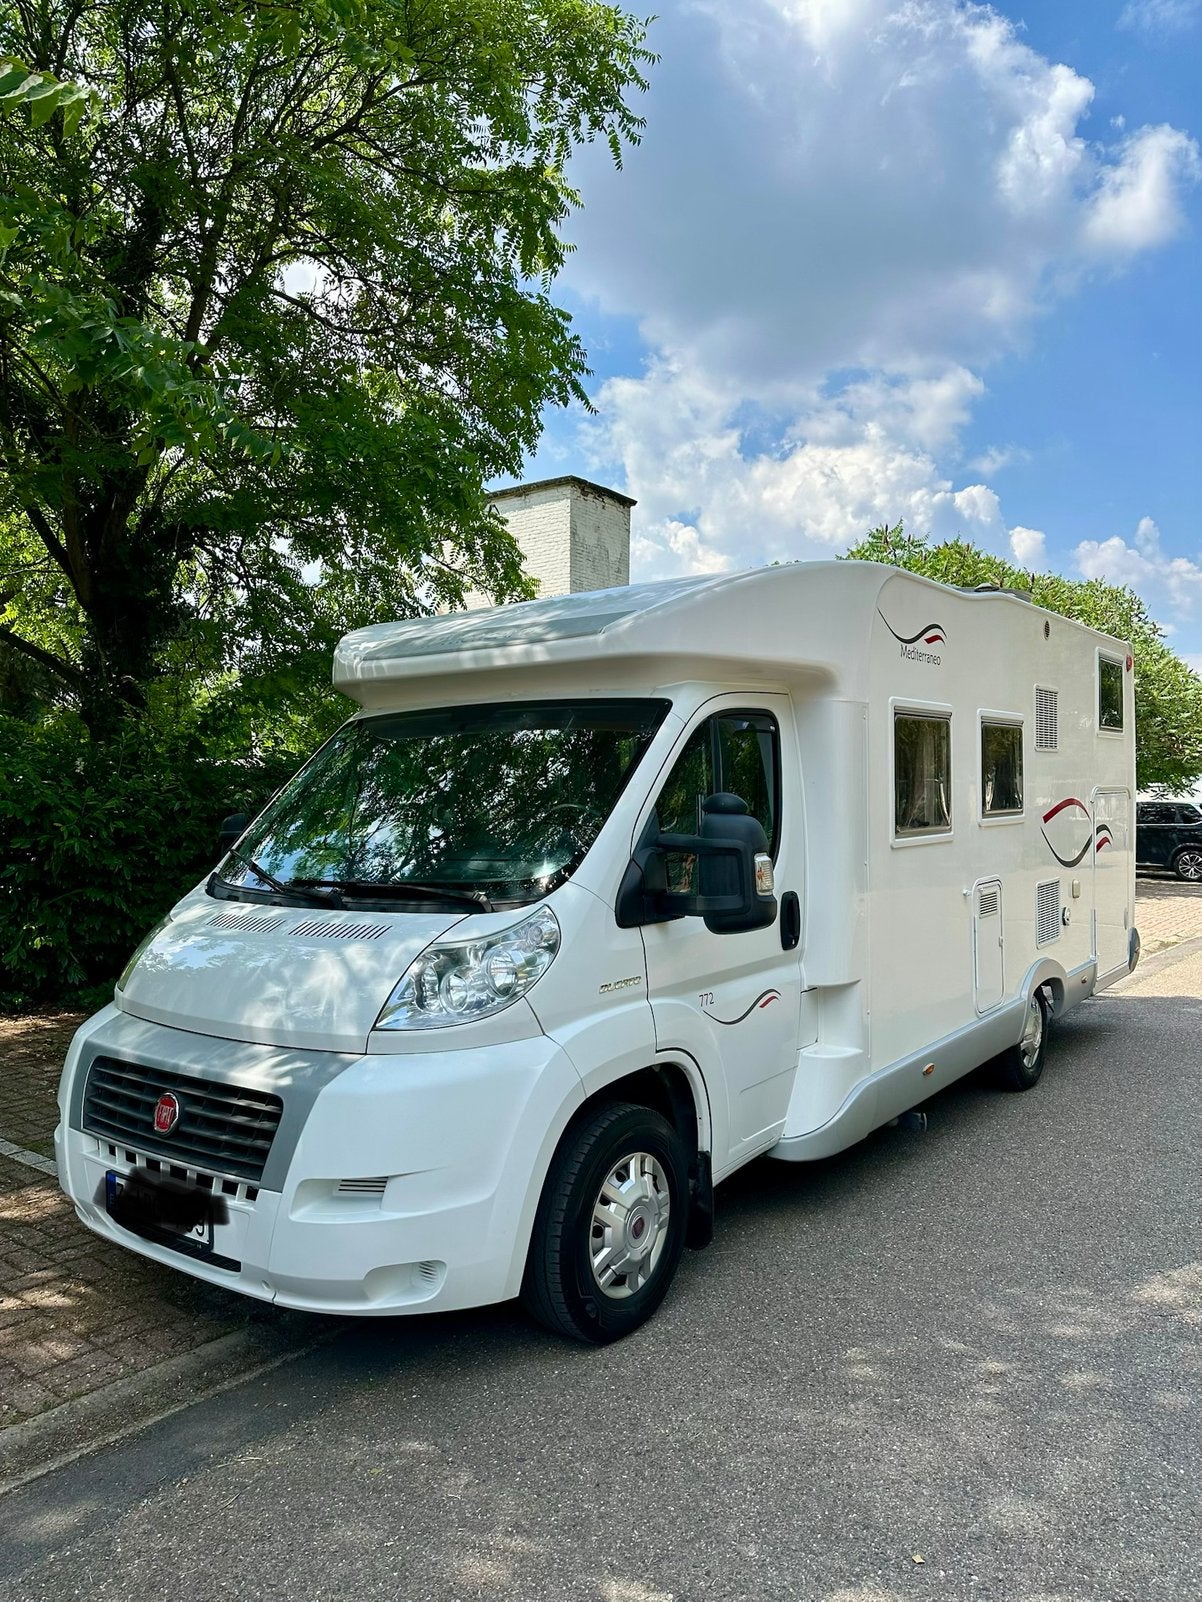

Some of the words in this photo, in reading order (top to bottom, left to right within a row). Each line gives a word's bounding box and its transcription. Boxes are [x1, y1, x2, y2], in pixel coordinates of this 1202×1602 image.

[900, 644, 942, 666] Mediterraneo
[699, 992, 714, 1007] 772
[157, 1104, 174, 1123] FIAT
